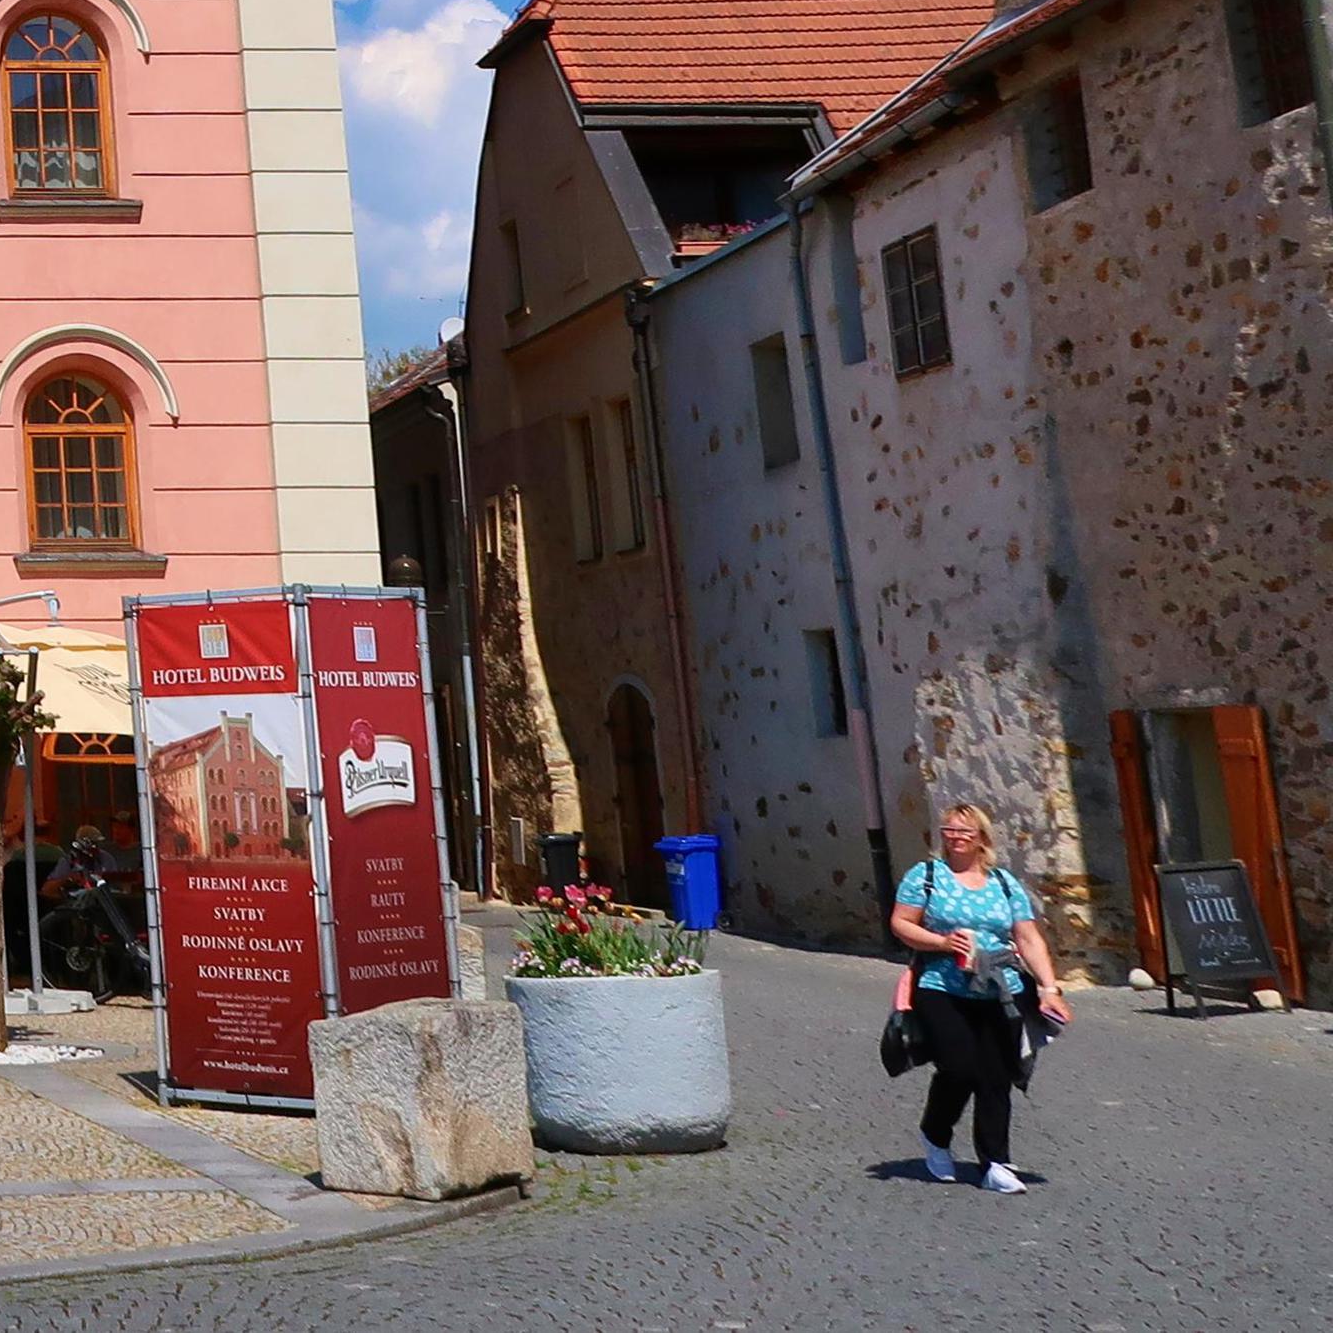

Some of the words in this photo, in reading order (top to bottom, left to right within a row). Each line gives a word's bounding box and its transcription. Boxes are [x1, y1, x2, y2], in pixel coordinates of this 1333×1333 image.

[153, 668, 207, 685] HOTEL
[210, 665, 285, 683] BUDWEIS
[319, 671, 362, 688] HOTEL
[364, 671, 417, 688] BUDWEIS
[366, 858, 404, 873] SVATBY
[188, 875, 248, 892] FIREMNÍ
[251, 878, 289, 893] AKCE
[370, 892, 406, 908] RAUTY
[213, 906, 266, 921] SVATBY
[182, 934, 245, 951] RODINNÉ
[249, 937, 304, 954] OSLAVY
[357, 926, 427, 945] KONFERENCE
[198, 964, 292, 983] KONFERENCE
[349, 962, 399, 981] RODINNÉ
[400, 959, 440, 977] OSLAVY
